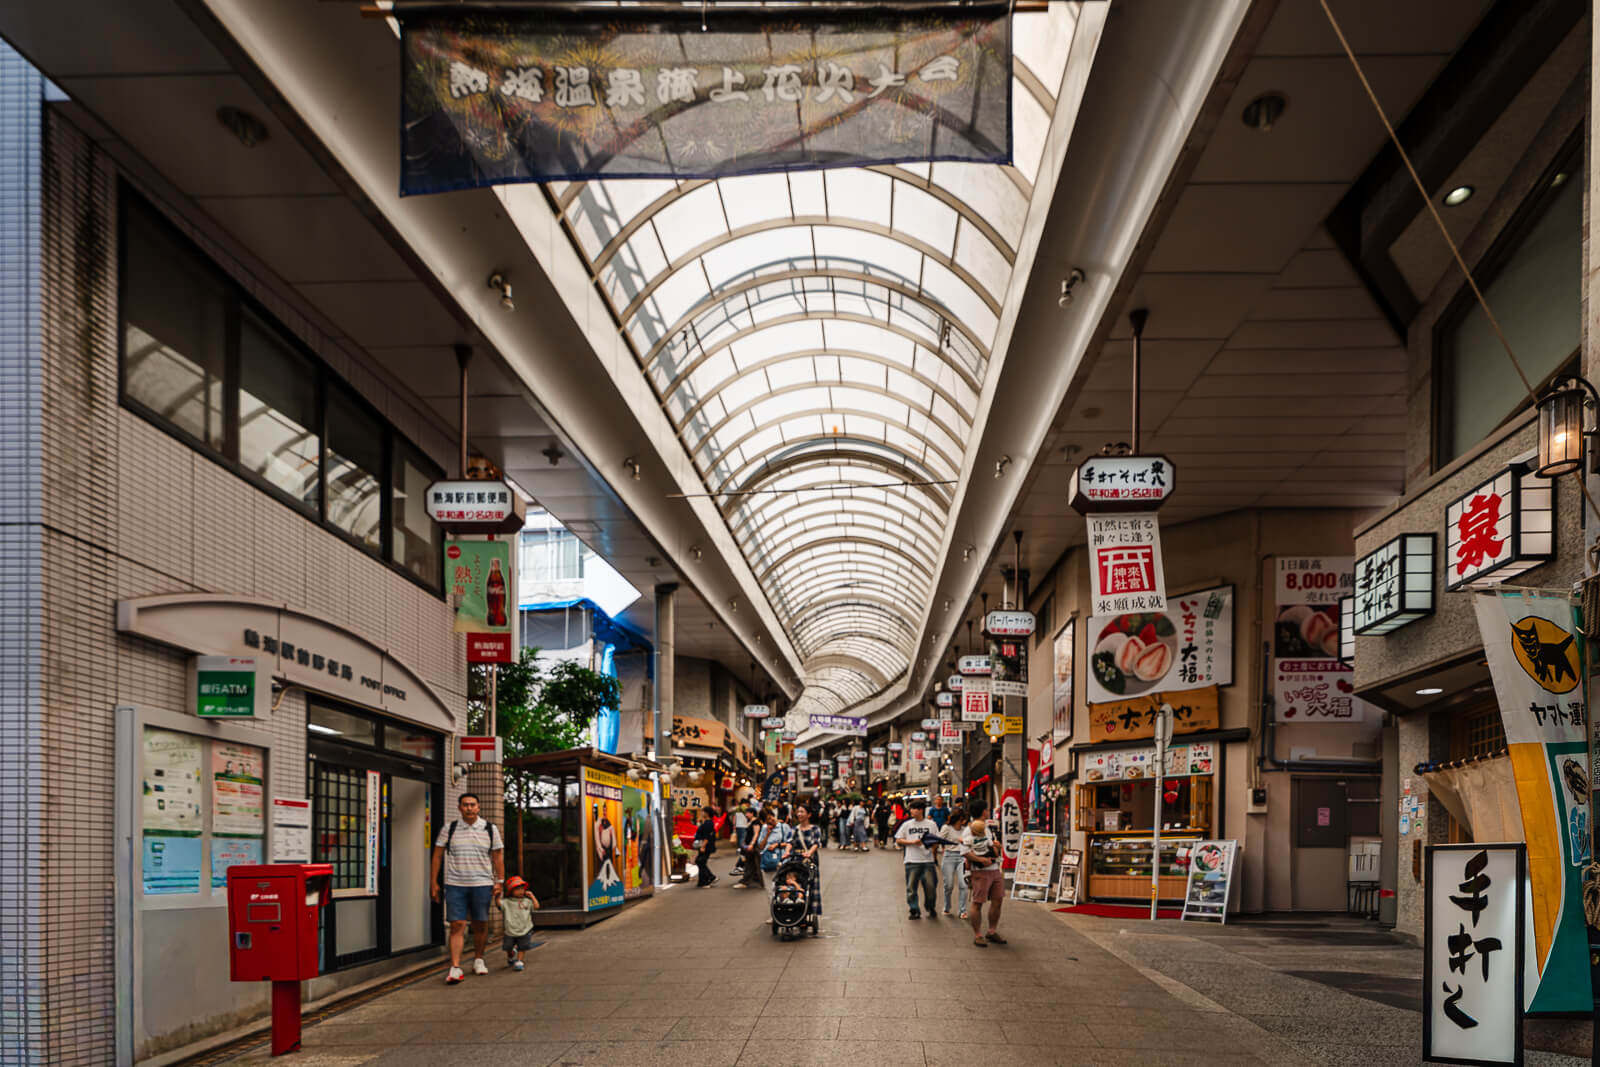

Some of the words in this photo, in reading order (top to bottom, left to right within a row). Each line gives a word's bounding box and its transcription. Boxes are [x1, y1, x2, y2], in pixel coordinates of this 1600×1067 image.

[449, 54, 960, 108] 熱海温泉海上花火大会
[1081, 466, 1149, 484] 手打そば
[433, 492, 507, 504] 熱海駅前郵便局
[1088, 488, 1163, 498] 平和通り名店街
[436, 510, 505, 520] 平和通り名店街
[1092, 519, 1153, 532] 自然に宿る
[1093, 532, 1154, 546] 神々に逢う
[1281, 559, 1322, 570] 1日最高
[1529, 701, 1585, 727] ヤマト運
[1003, 801, 1019, 853] たばこ
